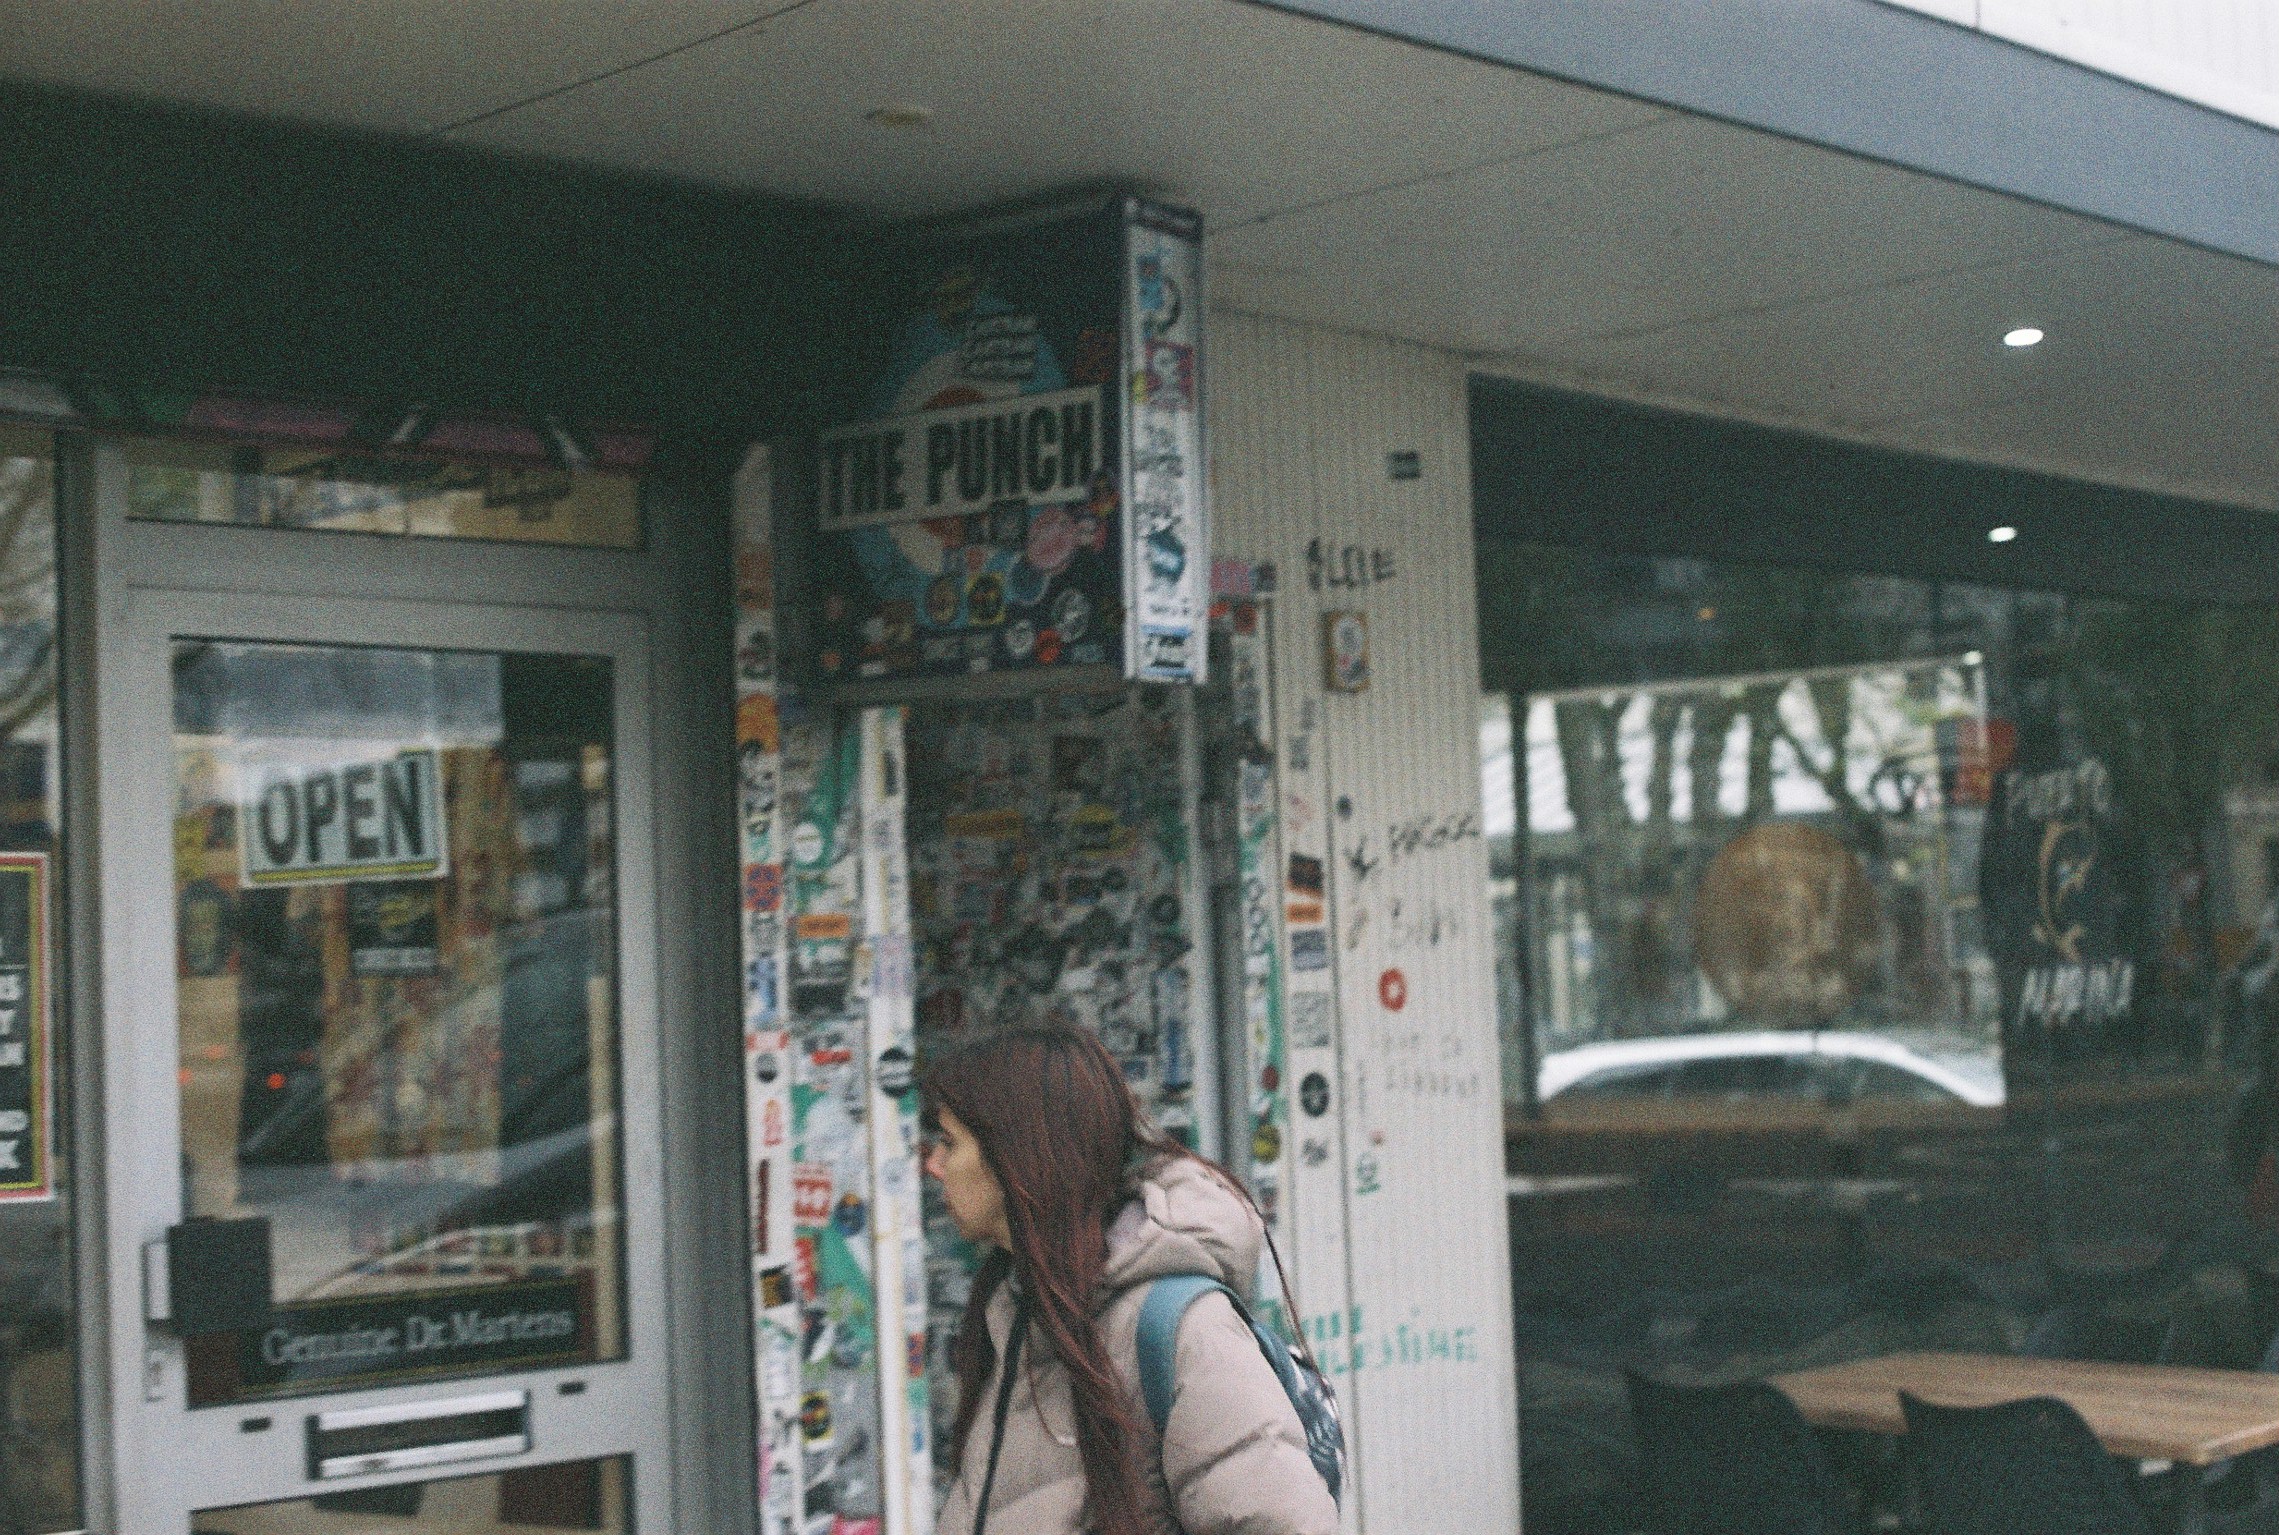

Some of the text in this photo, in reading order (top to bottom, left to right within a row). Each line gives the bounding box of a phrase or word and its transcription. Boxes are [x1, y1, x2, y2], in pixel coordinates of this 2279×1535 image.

[826, 403, 1092, 526] THE PUNCH
[257, 755, 425, 866] OPEN
[261, 1324, 397, 1366] Genuine
